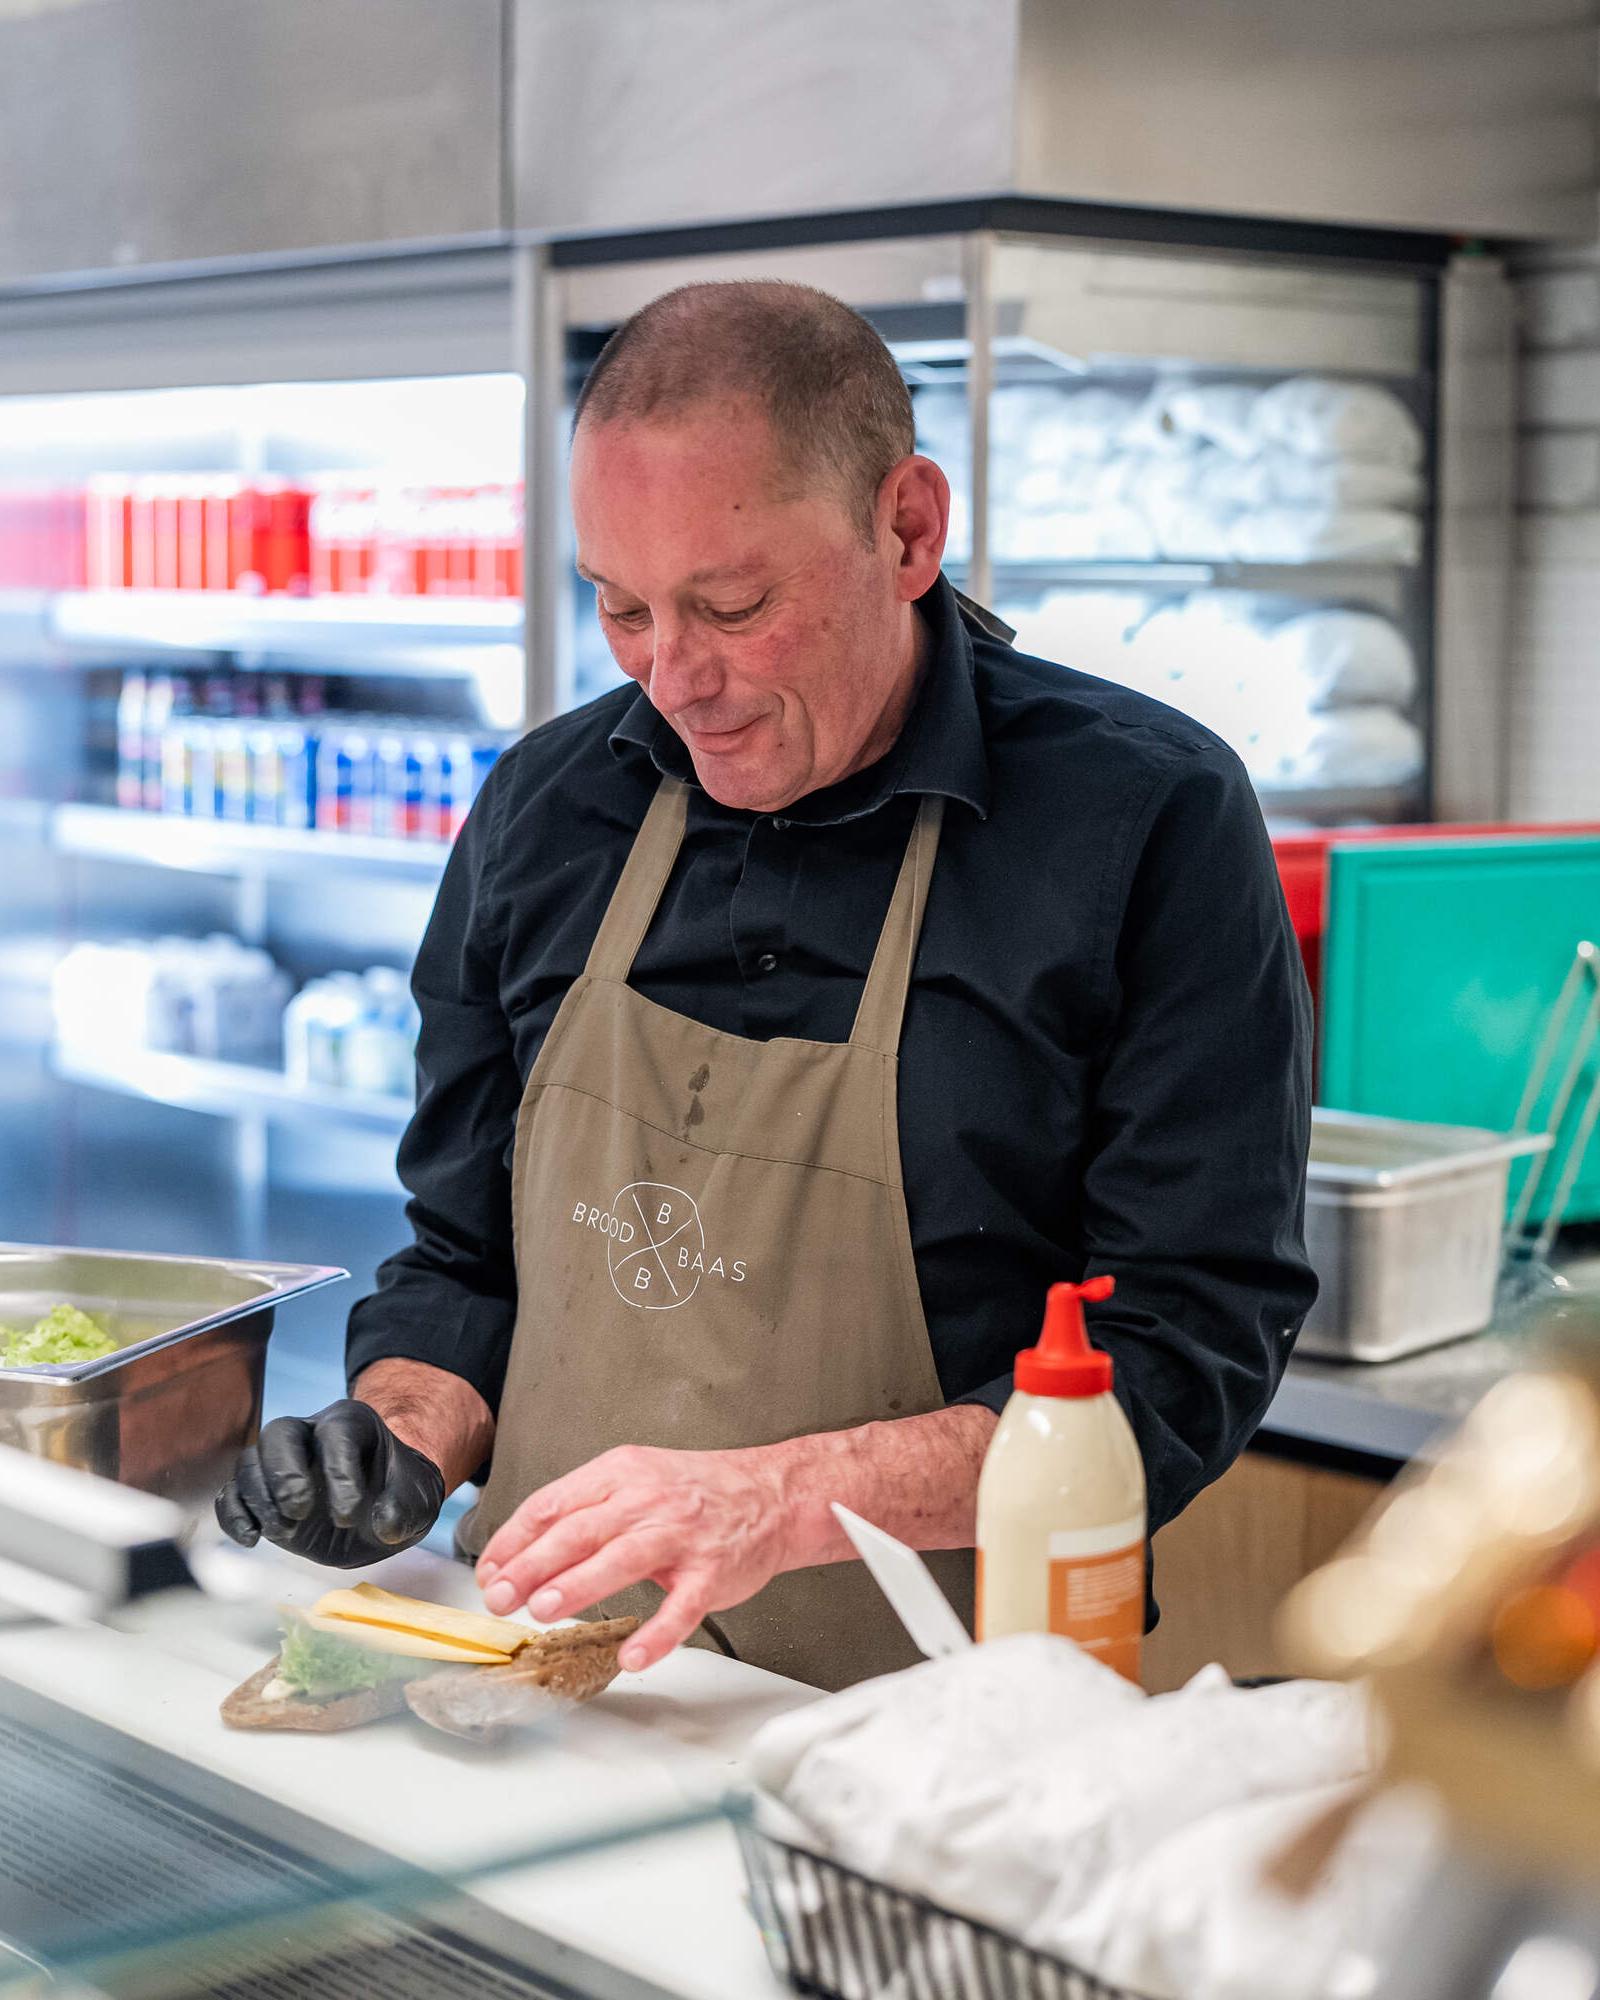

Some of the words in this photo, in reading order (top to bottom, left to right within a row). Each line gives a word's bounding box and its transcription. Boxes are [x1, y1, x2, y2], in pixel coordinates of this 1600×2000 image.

[656, 1202, 672, 1225] B
[572, 1201, 635, 1243] BROOD
[677, 1246, 747, 1282] BAAS
[633, 1266, 652, 1290] B
